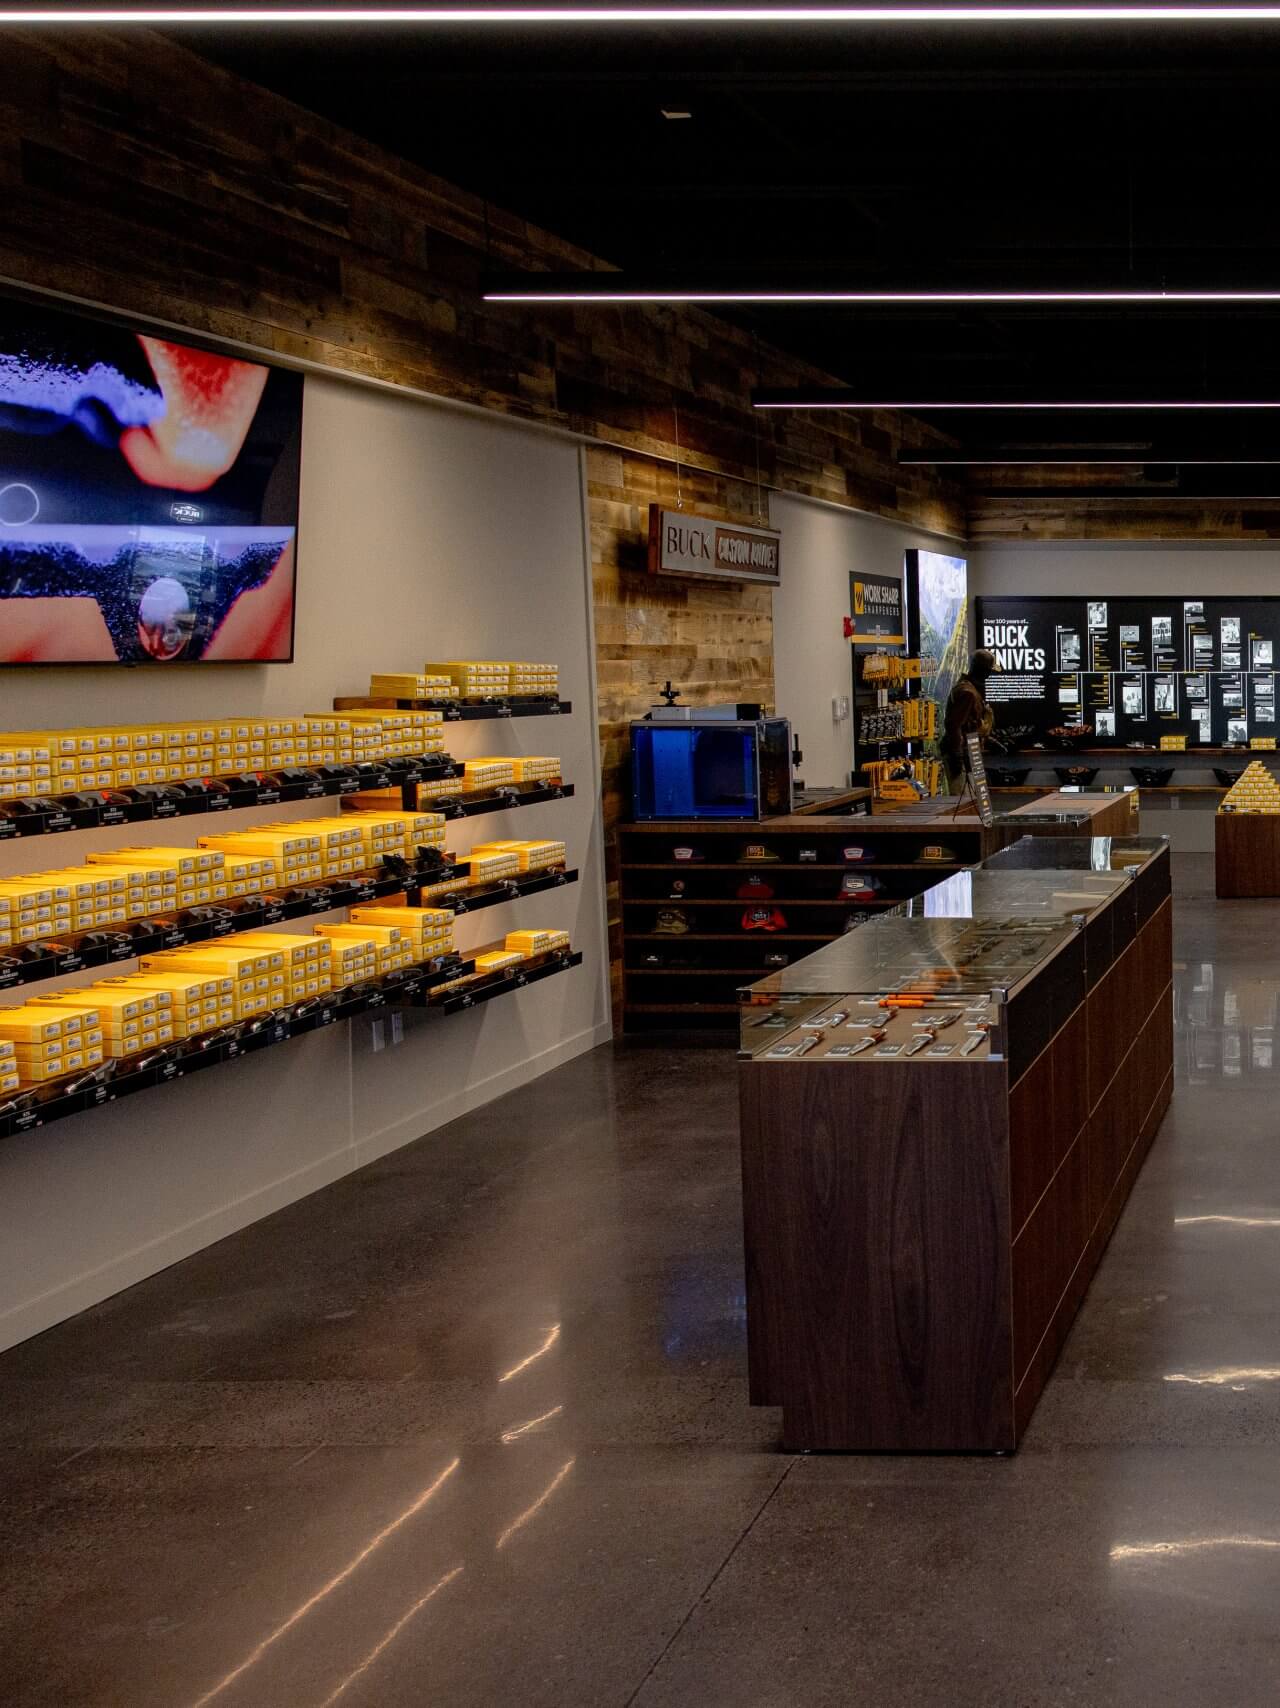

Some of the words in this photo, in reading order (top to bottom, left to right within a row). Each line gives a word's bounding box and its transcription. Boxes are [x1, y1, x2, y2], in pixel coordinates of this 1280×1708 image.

[667, 526, 711, 560] BUCK
[864, 583, 881, 604] WORK
[882, 586, 899, 606] SHARP
[864, 604, 899, 616] SHARPENERS
[983, 625, 1029, 647] BUCK
[984, 648, 1046, 670] NIVES
